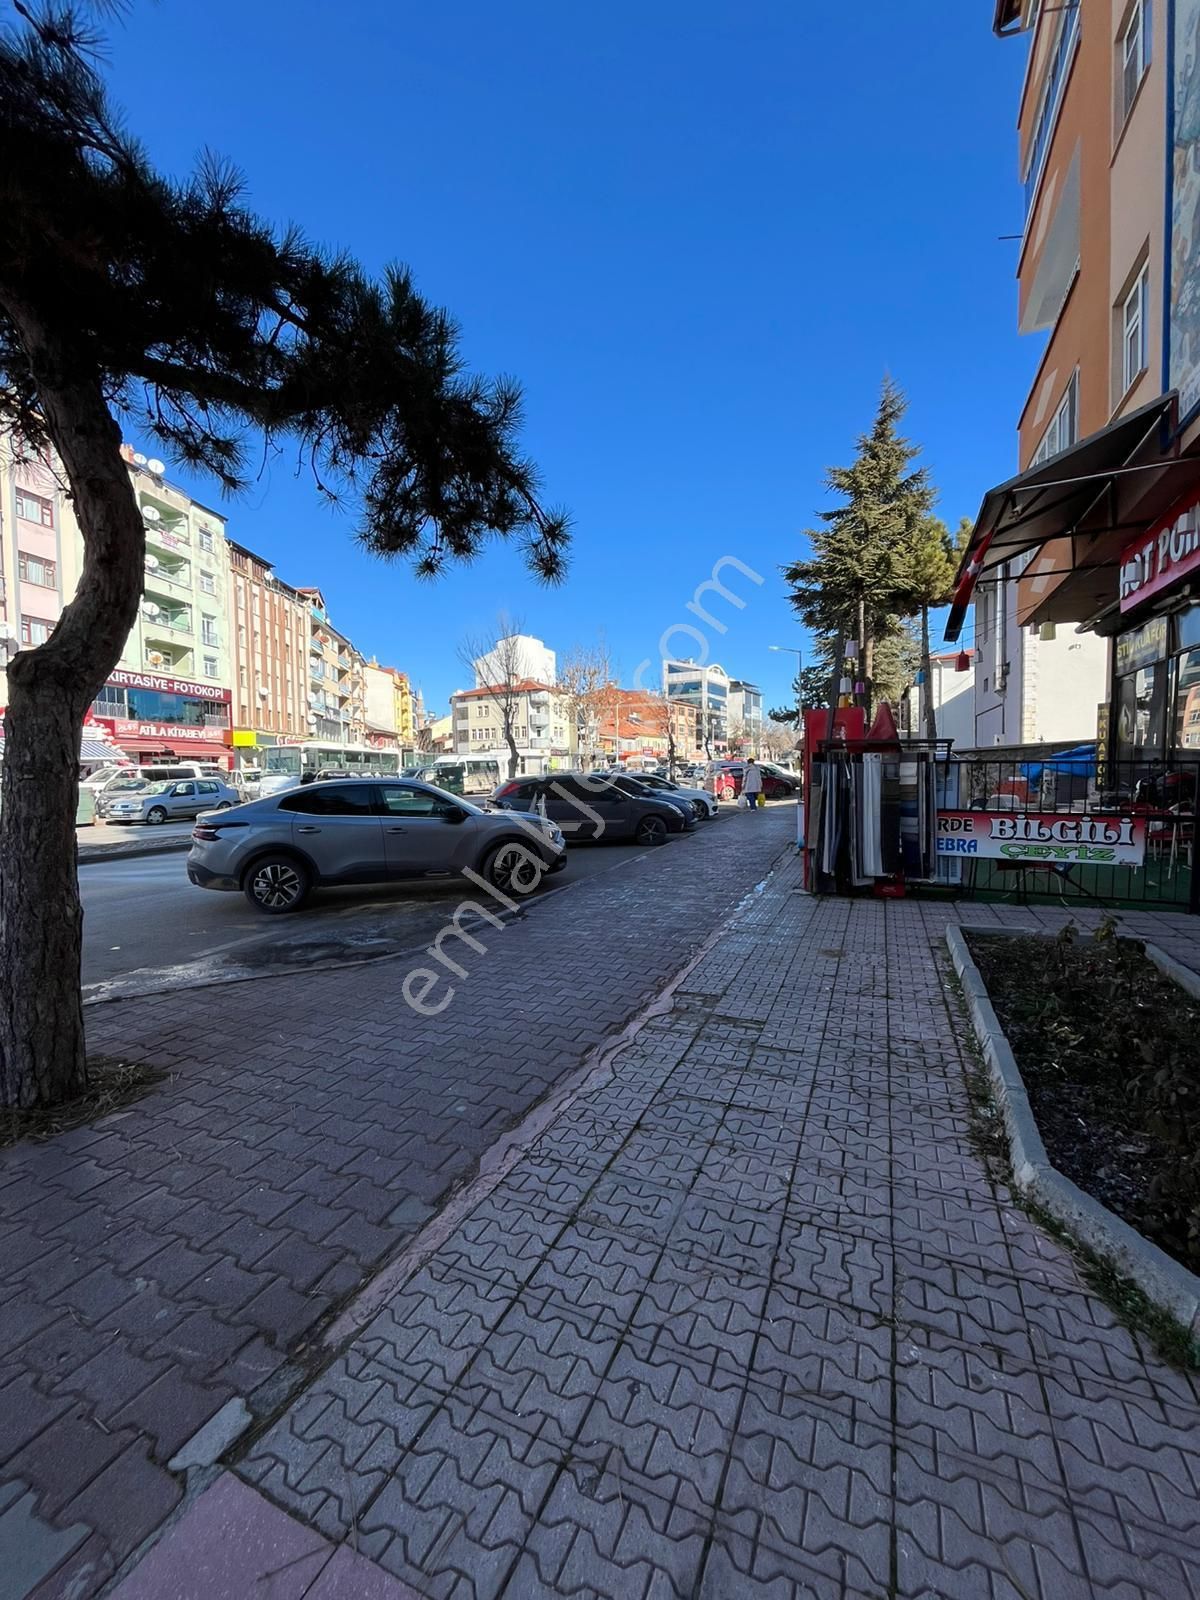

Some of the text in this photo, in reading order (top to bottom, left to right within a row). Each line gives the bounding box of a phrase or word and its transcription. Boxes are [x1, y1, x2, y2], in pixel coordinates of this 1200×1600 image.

[139, 723, 166, 737] ATİLA
[989, 814, 1135, 847] BİLGİLİ
[1000, 843, 1116, 862] ÇEYİZ
